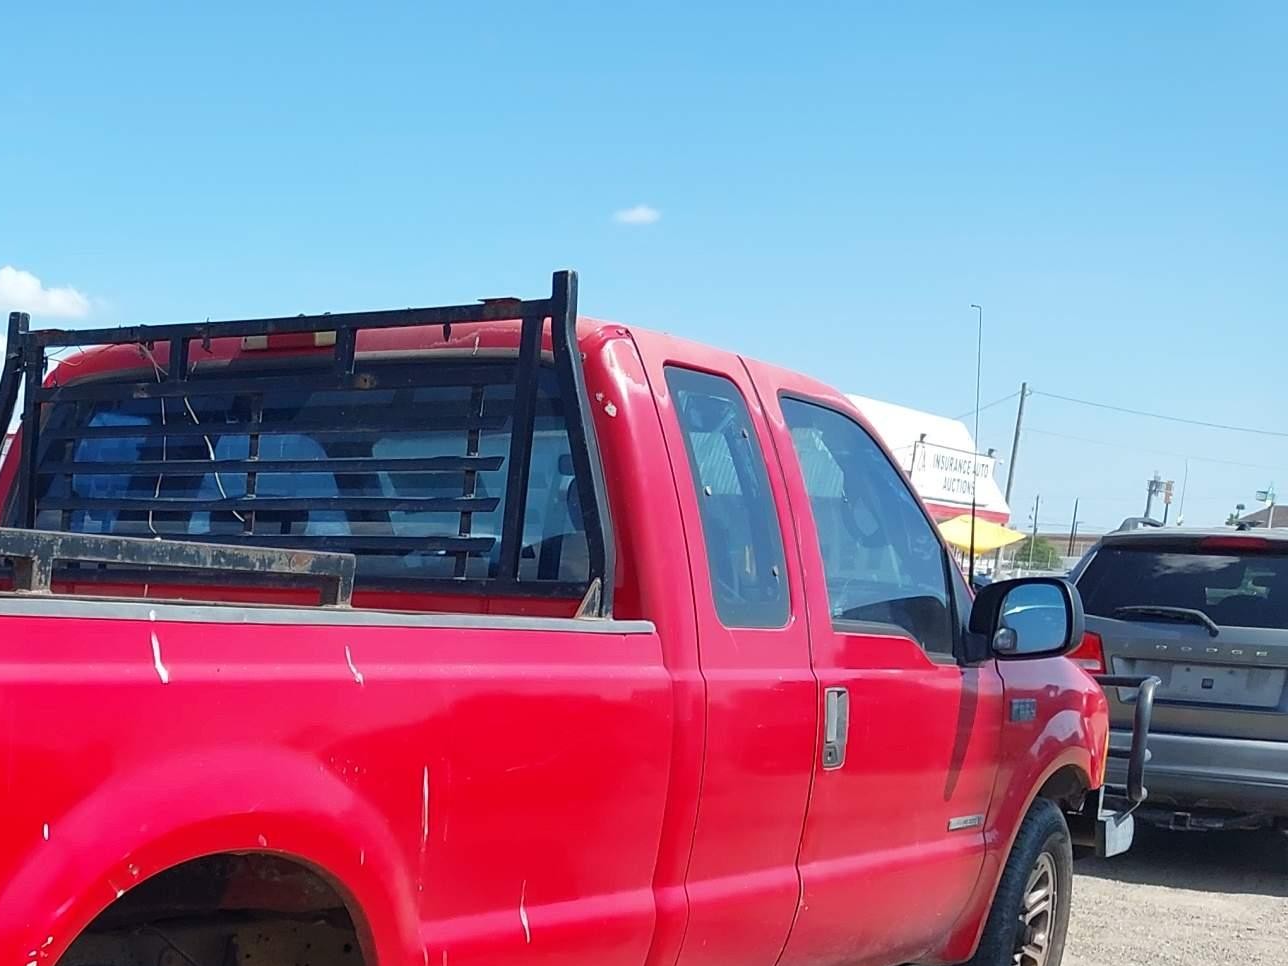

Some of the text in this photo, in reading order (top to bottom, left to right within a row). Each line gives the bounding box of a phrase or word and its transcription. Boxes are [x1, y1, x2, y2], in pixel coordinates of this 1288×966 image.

[933, 453, 972, 476] INSURANCE
[972, 461, 989, 478] AUTO
[942, 476, 975, 496] AUCTIONS
